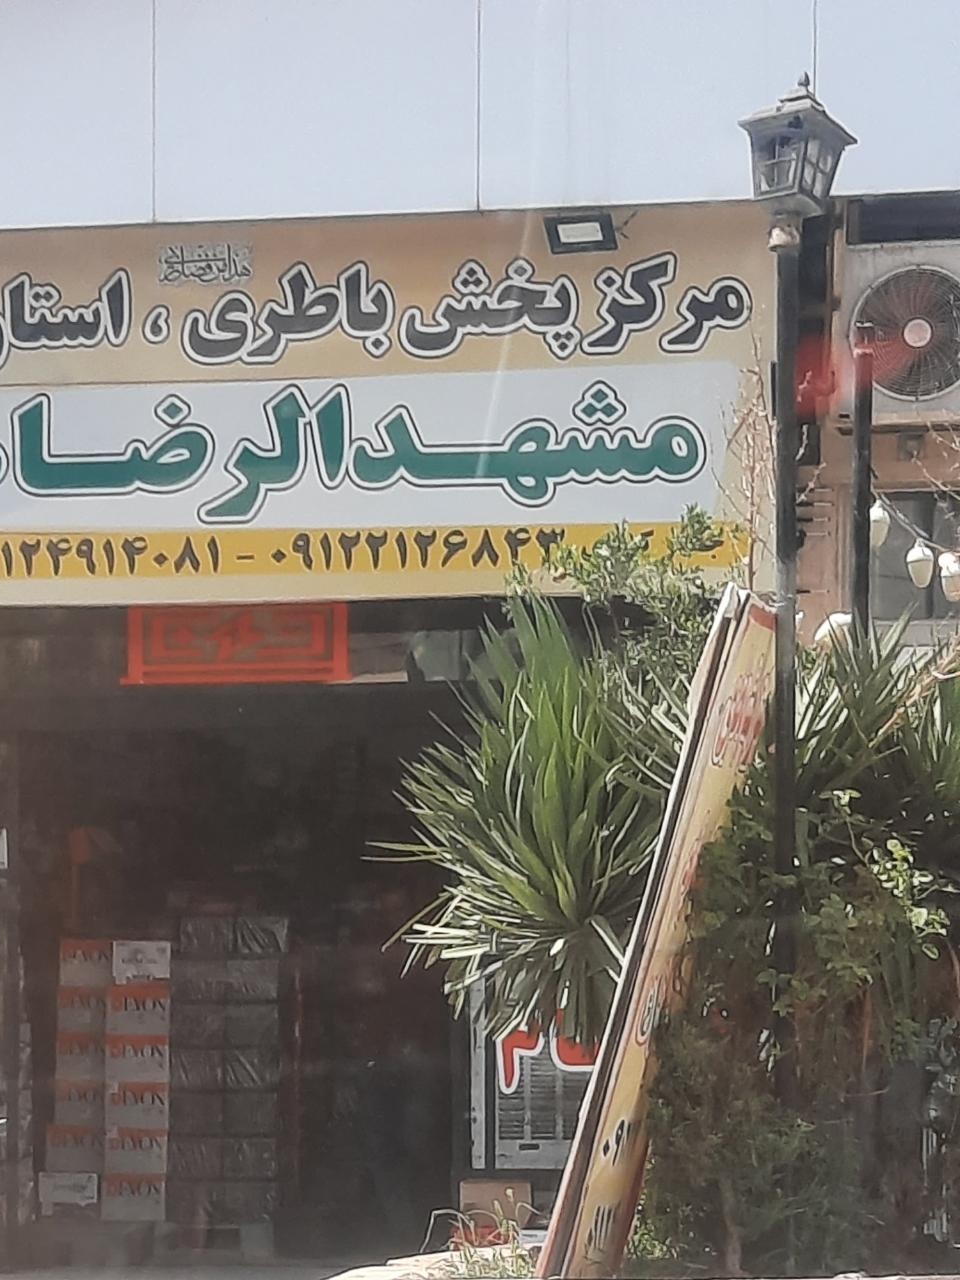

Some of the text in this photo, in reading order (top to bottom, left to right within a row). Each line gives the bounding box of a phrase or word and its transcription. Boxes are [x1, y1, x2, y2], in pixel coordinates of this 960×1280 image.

[181, 260, 396, 365] باطری
[398, 256, 580, 360] پخش
[581, 250, 752, 355] مرکز
